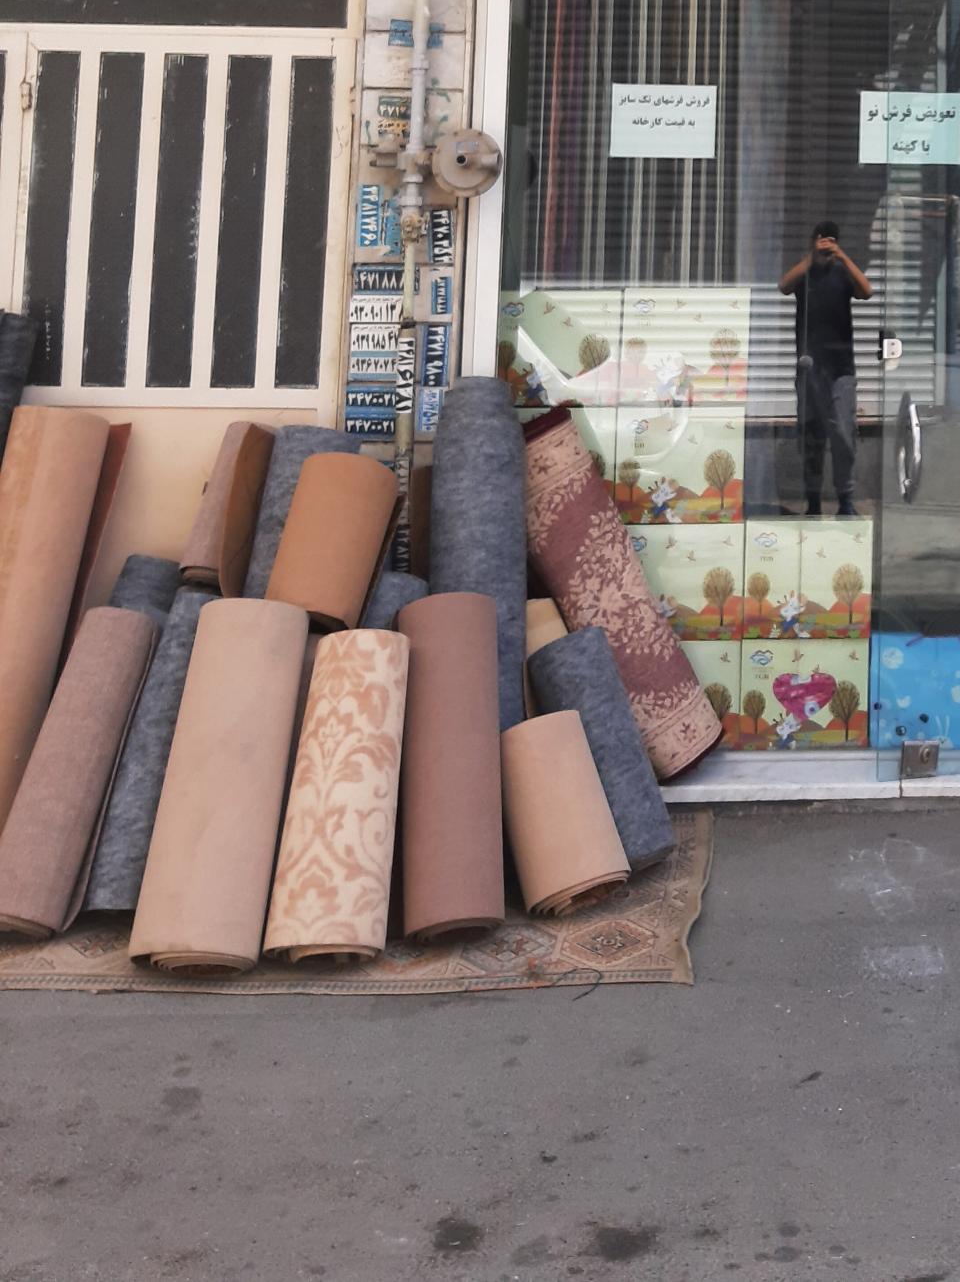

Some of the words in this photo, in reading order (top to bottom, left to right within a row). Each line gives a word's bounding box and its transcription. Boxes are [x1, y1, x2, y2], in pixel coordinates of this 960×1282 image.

[686, 95, 710, 107] فروش
[867, 104, 879, 122] نو
[881, 104, 912, 122] فرش
[915, 106, 957, 123] تعویض
[632, 117, 663, 129] کارخانه
[664, 118, 686, 129] قیمت
[687, 120, 696, 129] به
[892, 139, 918, 155] کهنه
[921, 139, 930, 156] با
